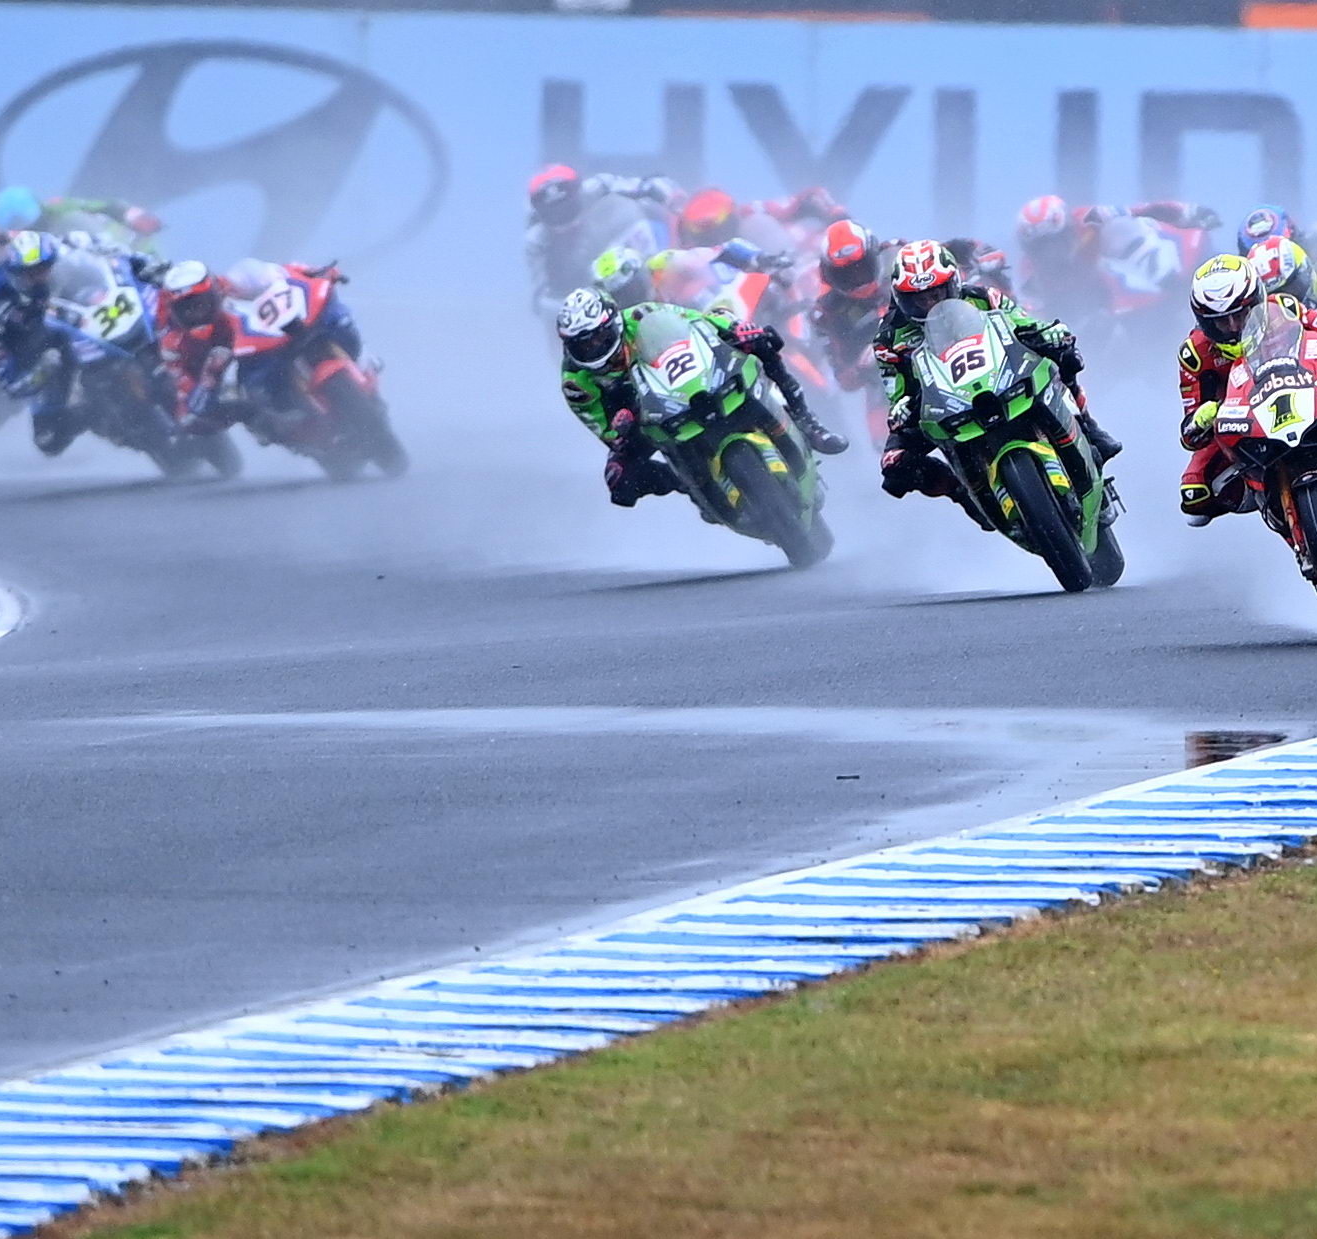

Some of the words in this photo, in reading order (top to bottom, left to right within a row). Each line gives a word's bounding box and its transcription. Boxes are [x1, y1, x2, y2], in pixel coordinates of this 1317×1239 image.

[258, 289, 293, 326] 97
[665, 351, 697, 386] 22
[950, 349, 986, 384] 65
[1249, 371, 1313, 406] aruba.it
[1218, 421, 1249, 433] Lenovo
[1268, 391, 1305, 434] 1
